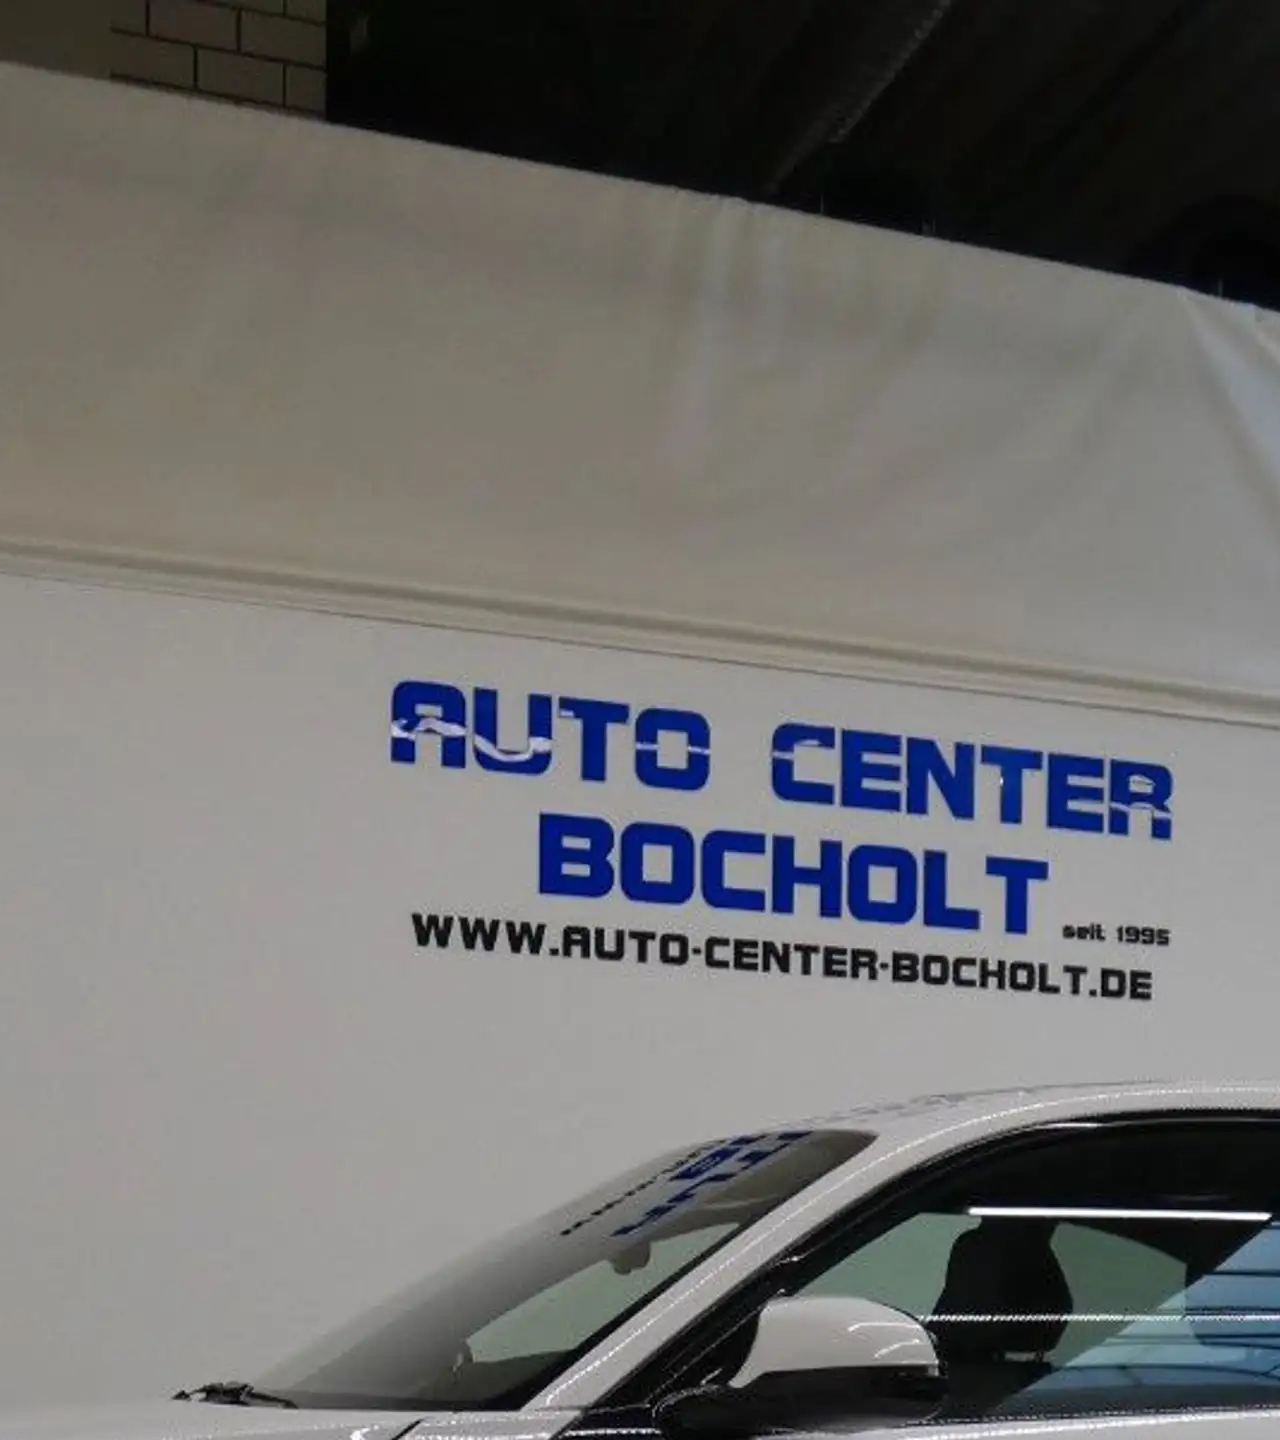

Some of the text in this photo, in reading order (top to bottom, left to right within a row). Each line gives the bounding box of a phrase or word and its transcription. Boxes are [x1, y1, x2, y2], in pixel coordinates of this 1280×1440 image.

[391, 680, 1173, 841] AUTO CENTER
[538, 812, 1170, 946] BOCHOLT seit 1995
[411, 912, 1153, 1001] WWW.AUTO-CENTER-BOCHOLT.DE
